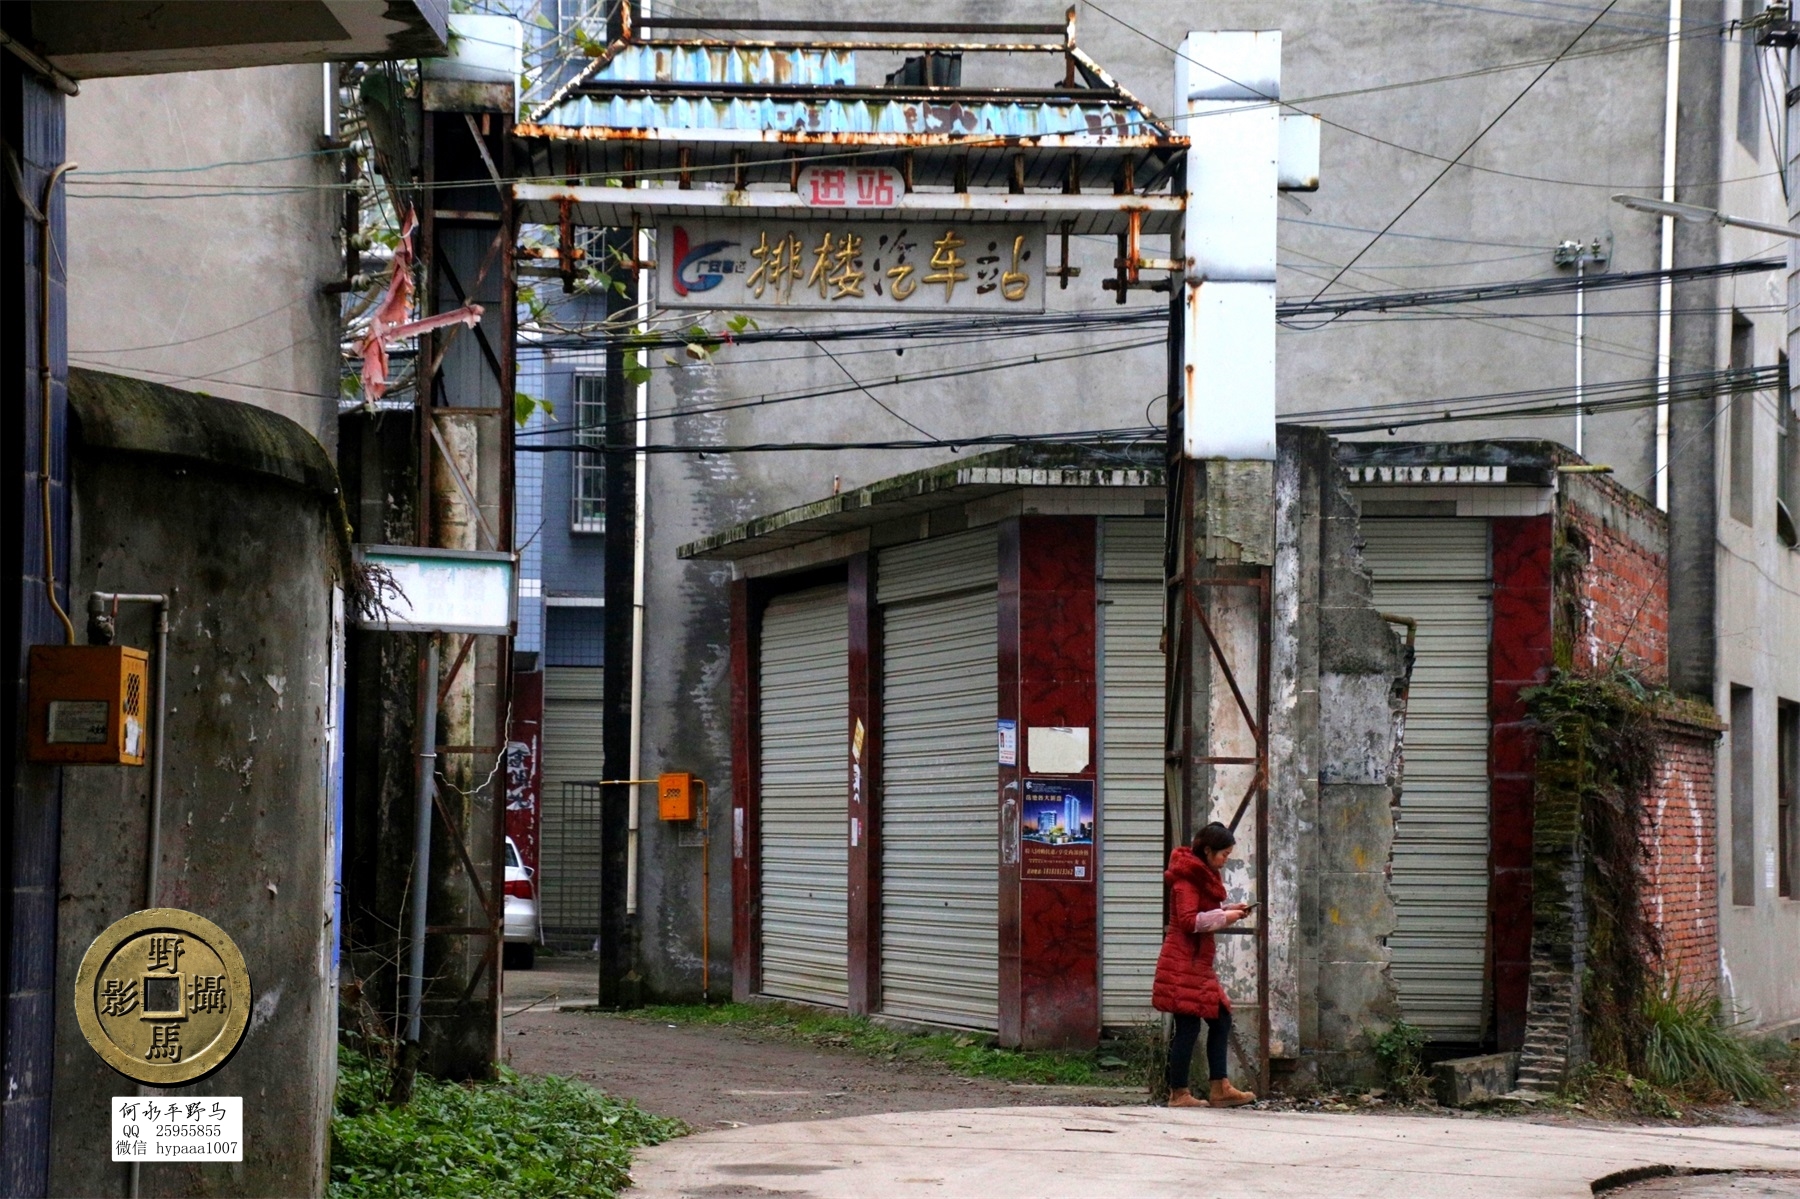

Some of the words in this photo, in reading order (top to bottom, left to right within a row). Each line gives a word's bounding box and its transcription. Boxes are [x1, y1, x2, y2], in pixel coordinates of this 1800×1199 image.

[810, 168, 893, 205] 进站
[746, 228, 1031, 302] 排楼汽车站
